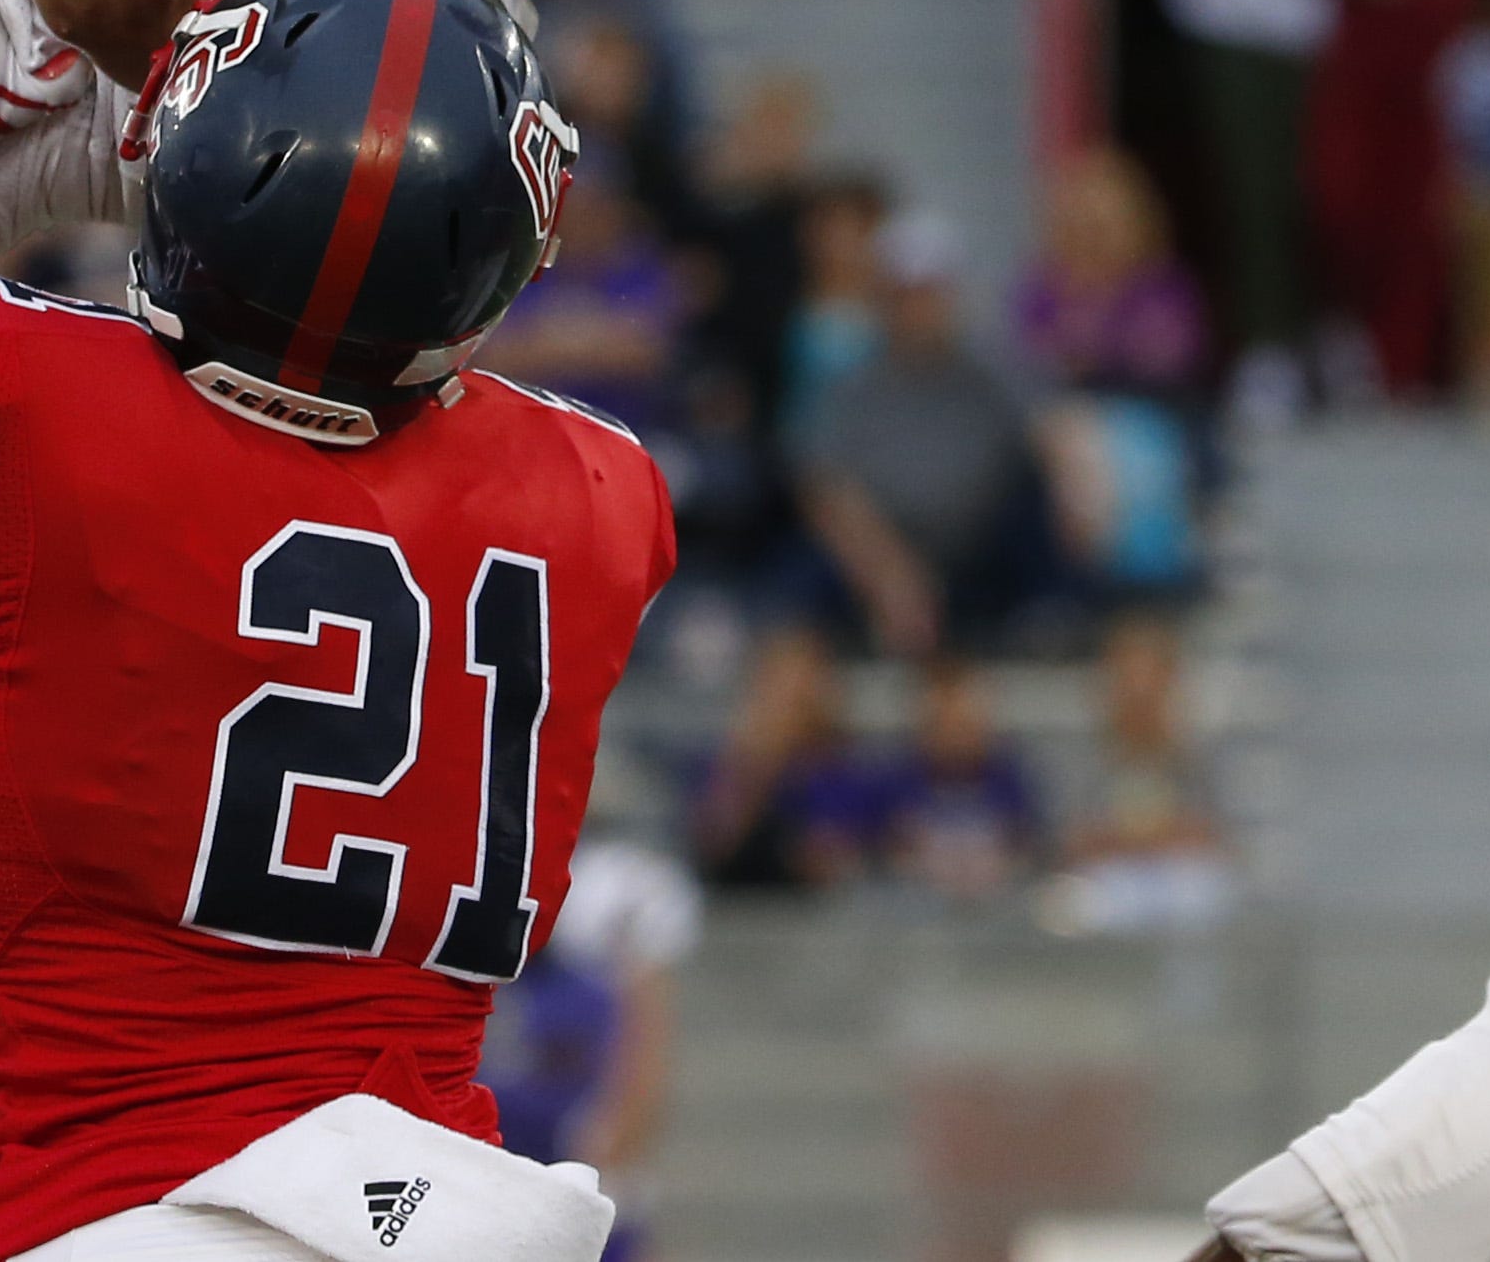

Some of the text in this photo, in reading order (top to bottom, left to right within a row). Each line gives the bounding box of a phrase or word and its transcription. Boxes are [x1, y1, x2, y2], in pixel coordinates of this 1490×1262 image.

[209, 374, 363, 434] schutt
[179, 518, 551, 985] 21
[379, 1176, 432, 1249] adidas
